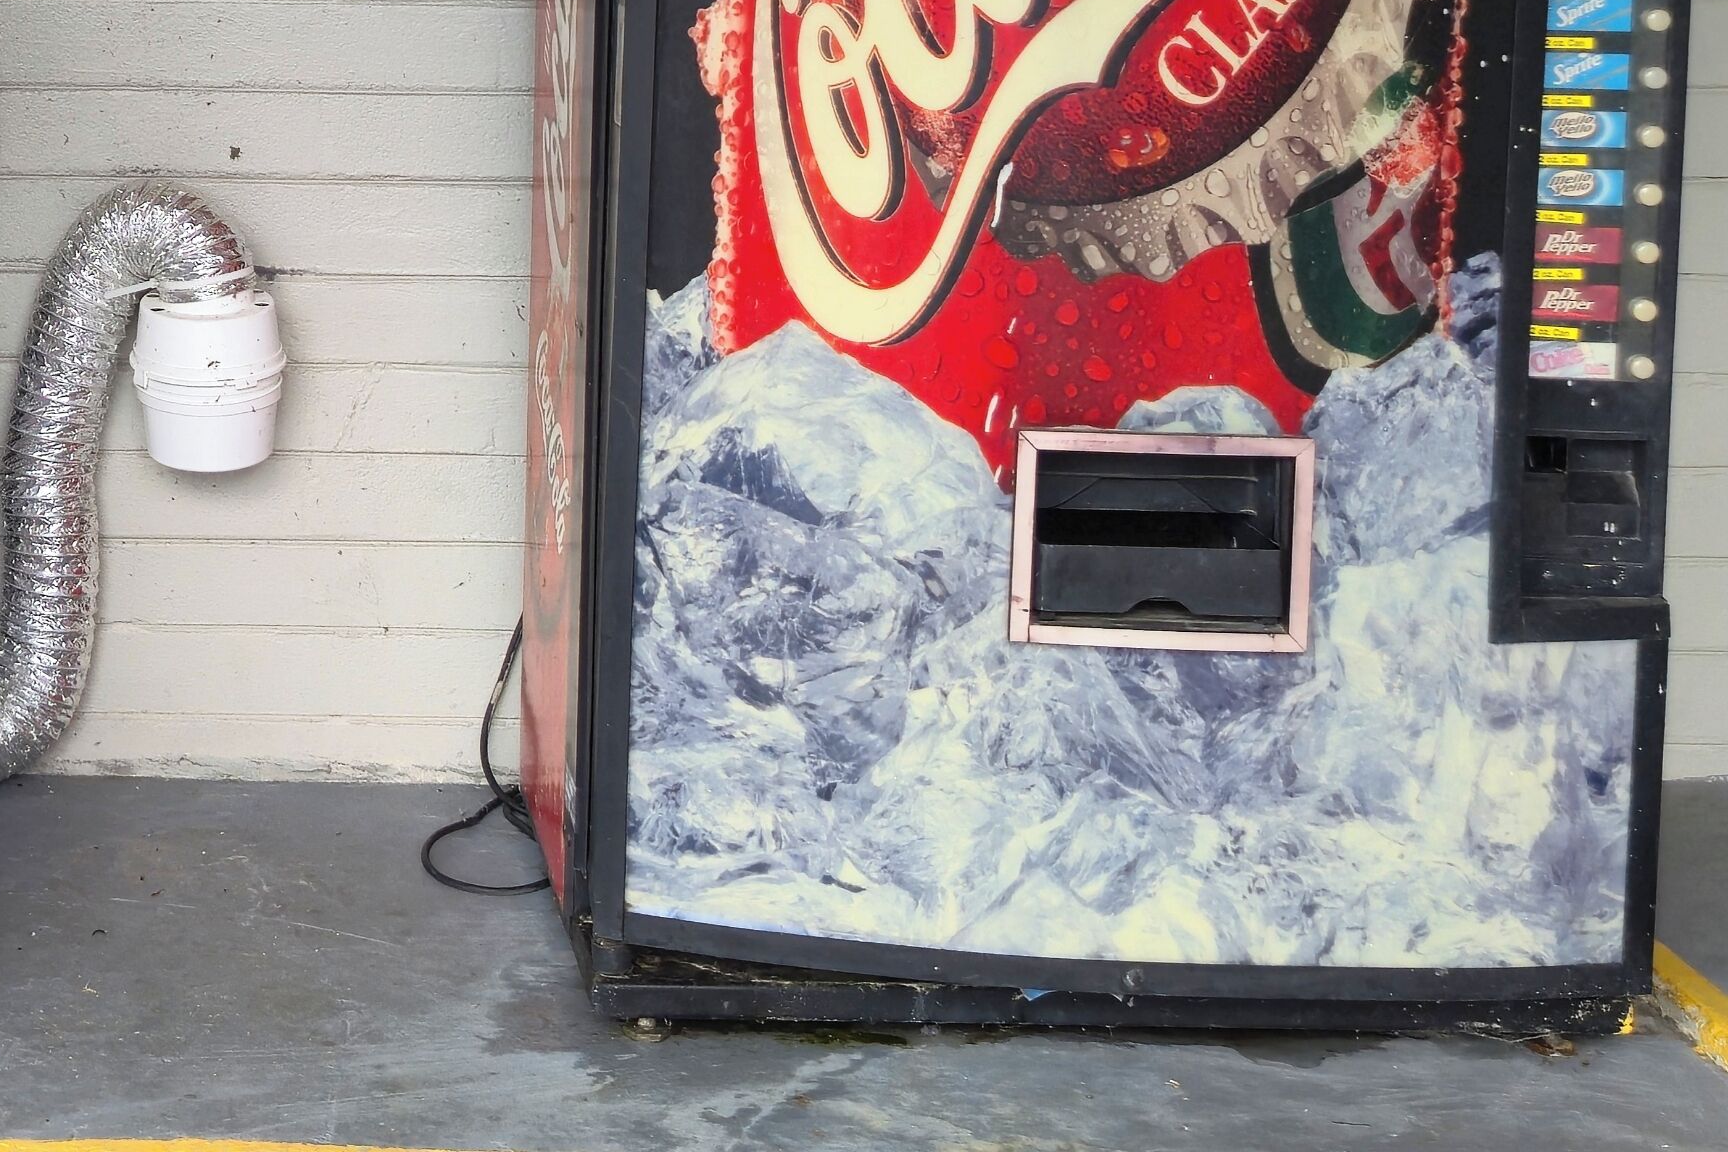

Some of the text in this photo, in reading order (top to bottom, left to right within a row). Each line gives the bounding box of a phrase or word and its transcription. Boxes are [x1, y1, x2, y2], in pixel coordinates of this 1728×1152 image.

[1552, 53, 1604, 86] Sprite
[1541, 233, 1598, 256] Pepper
[1561, 230, 1584, 243] Dr
[1539, 290, 1596, 313] Pepper
[1560, 287, 1583, 300] Dr
[534, 328, 572, 556] Coca-Cola
